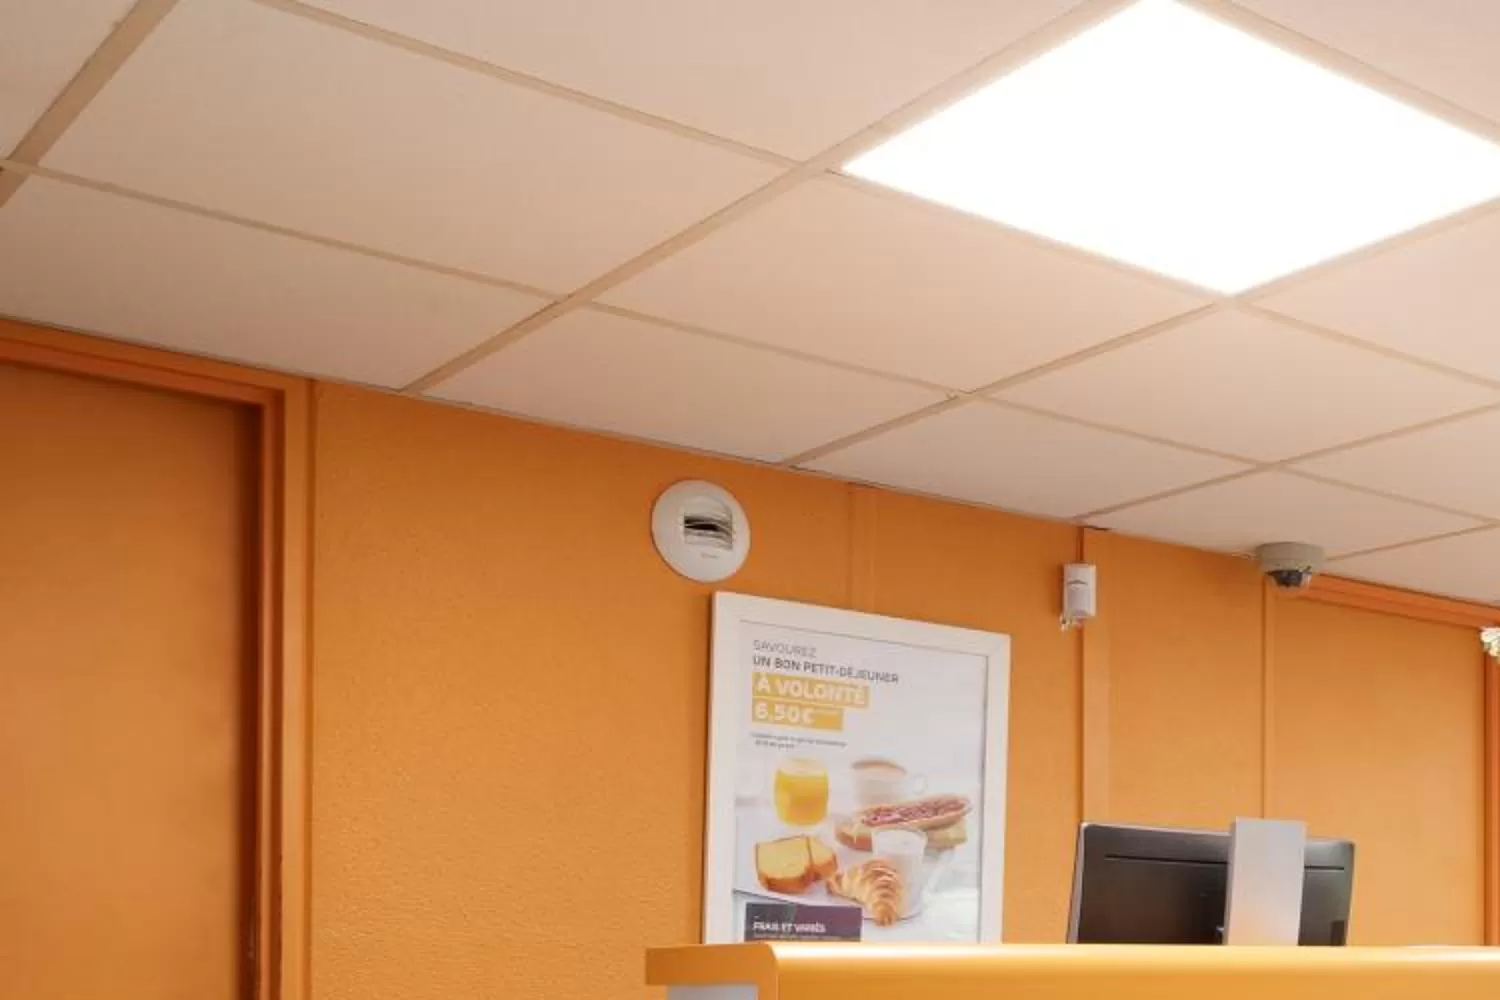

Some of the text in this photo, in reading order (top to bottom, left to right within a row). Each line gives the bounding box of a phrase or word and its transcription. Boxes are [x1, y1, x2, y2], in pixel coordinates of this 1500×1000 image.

[753, 655, 771, 668] UN
[775, 657, 801, 672] BON
[757, 672, 865, 705] À VOLONTÉ
